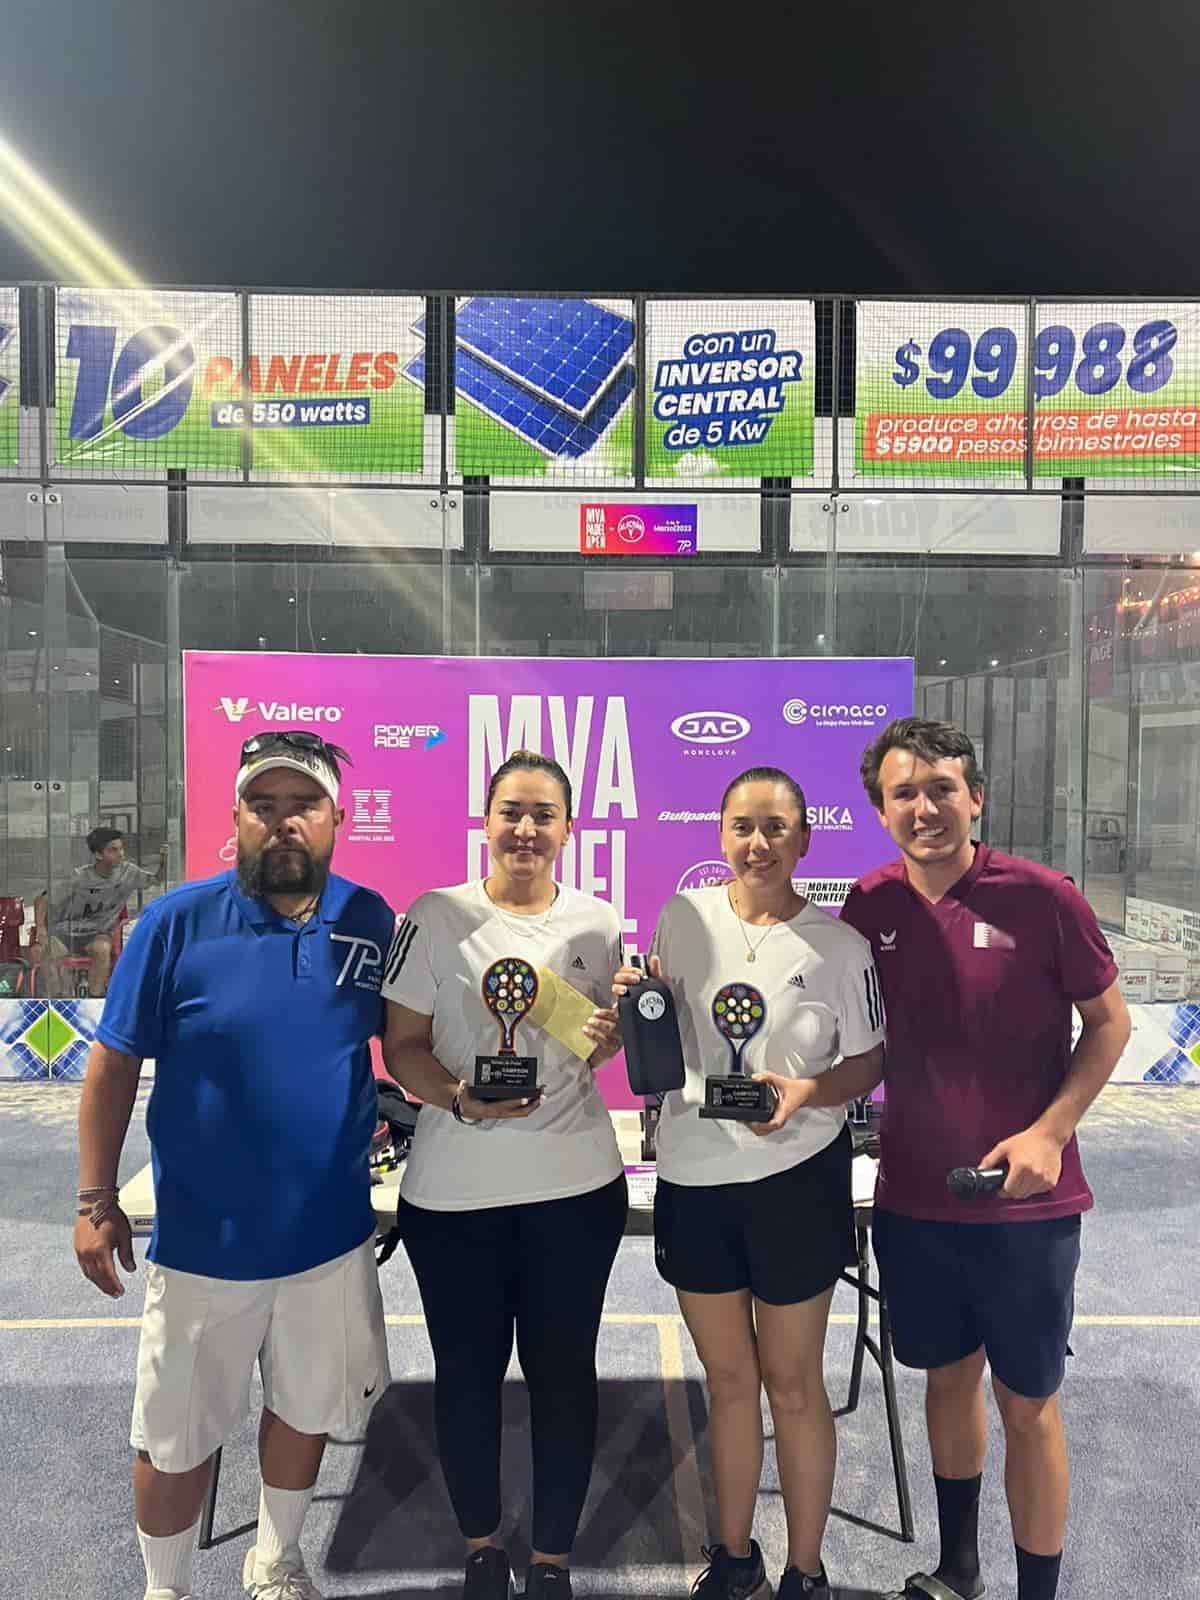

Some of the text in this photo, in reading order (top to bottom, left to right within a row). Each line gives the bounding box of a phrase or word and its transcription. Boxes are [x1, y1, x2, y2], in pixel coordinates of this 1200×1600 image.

[688, 332, 771, 356] con un
[65, 324, 195, 441] 10
[203, 351, 399, 394] PANELES
[658, 355, 798, 387] INVERSOR
[216, 401, 367, 424] de 550 watts
[657, 386, 782, 416] CENTRAL
[668, 418, 767, 446] de 5 Kw
[876, 408, 1197, 437] produce ahorros de hasta
[876, 430, 1182, 459] $5900 pesos bimestrales
[257, 702, 342, 722] Valero
[374, 725, 440, 737] POWER
[683, 721, 738, 735] JAC
[374, 737, 411, 748] ADE
[468, 695, 639, 818] MVA
